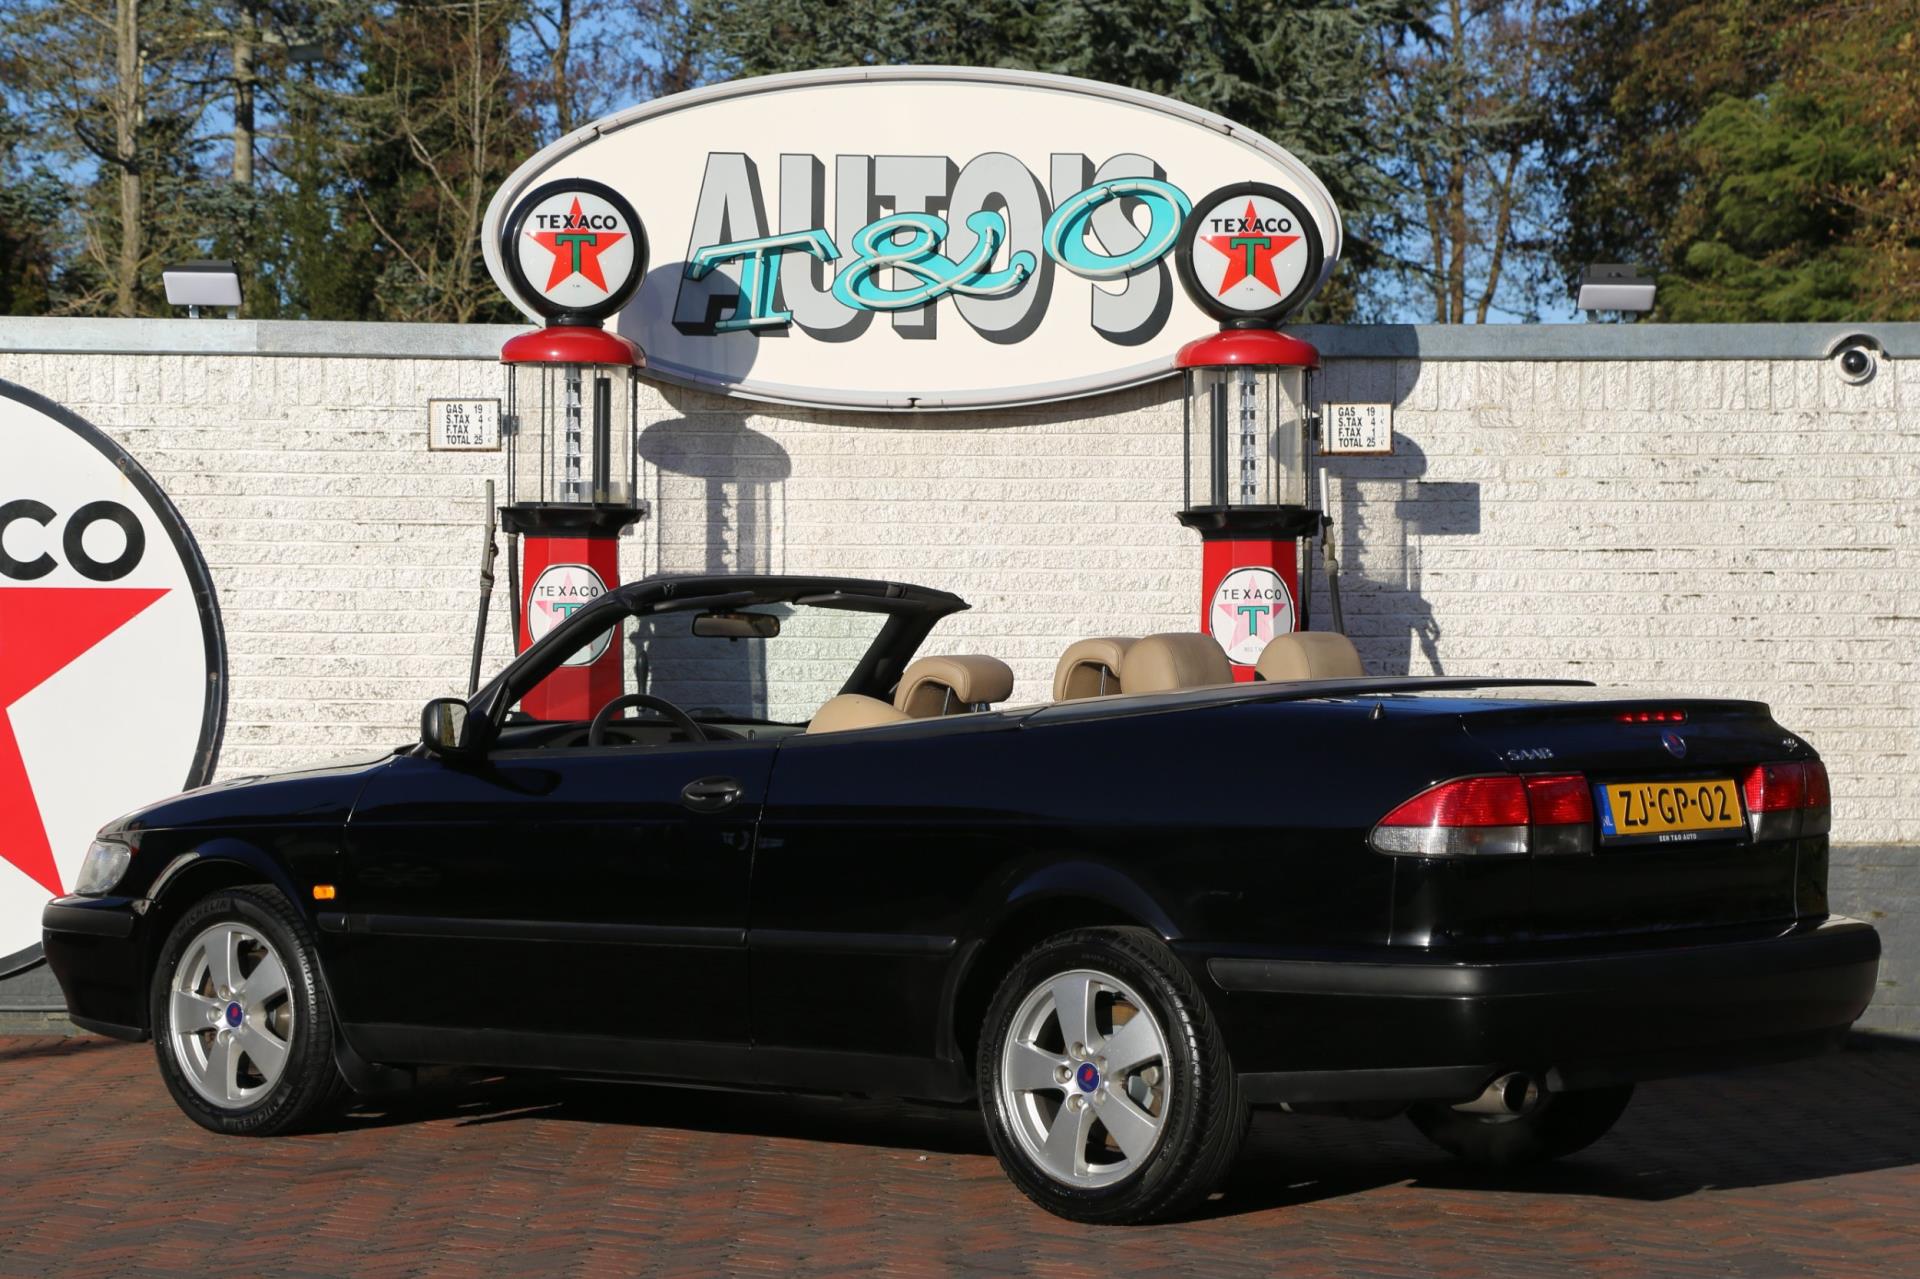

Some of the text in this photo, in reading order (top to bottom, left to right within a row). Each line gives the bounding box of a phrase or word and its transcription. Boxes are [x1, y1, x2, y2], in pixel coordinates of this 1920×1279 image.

[536, 214, 618, 230] TEXACO
[1211, 218, 1292, 233] TEXACO
[555, 233, 597, 273] T
[672, 152, 1173, 346] AUTO'S
[1230, 237, 1272, 276] T
[446, 404, 483, 414] GAS 19
[1338, 407, 1376, 416] GAS 19
[446, 415, 483, 424] S.TAX 4
[1338, 417, 1376, 427] S.TAX 4
[446, 425, 468, 434] F.TAX
[1338, 428, 1361, 437] F.TAX
[446, 435, 483, 445] TOTAL 25
[1338, 438, 1376, 447] TOTAL 25
[0, 499, 146, 582] CO
[539, 586, 599, 598] TEXACO
[1223, 589, 1282, 600] TEXACO
[1238, 606, 1270, 636] T
[1618, 786, 1732, 827] ZJ-GP-02
[1683, 833, 1697, 841] AUTO
